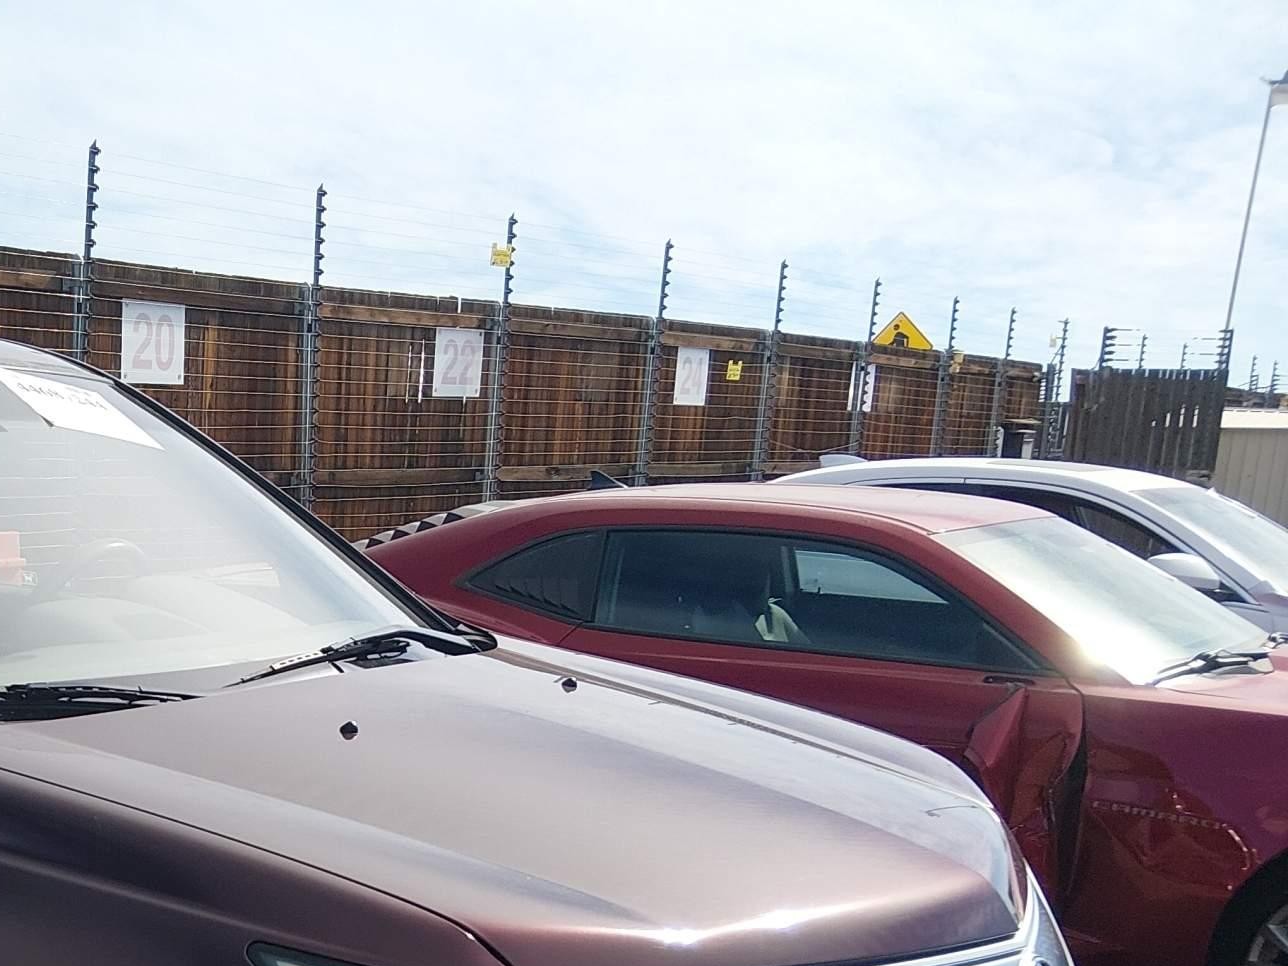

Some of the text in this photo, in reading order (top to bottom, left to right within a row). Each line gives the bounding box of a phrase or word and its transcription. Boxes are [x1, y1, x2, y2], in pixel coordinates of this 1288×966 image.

[133, 312, 175, 371] 20
[441, 339, 475, 386] 22
[680, 356, 703, 396] 24
